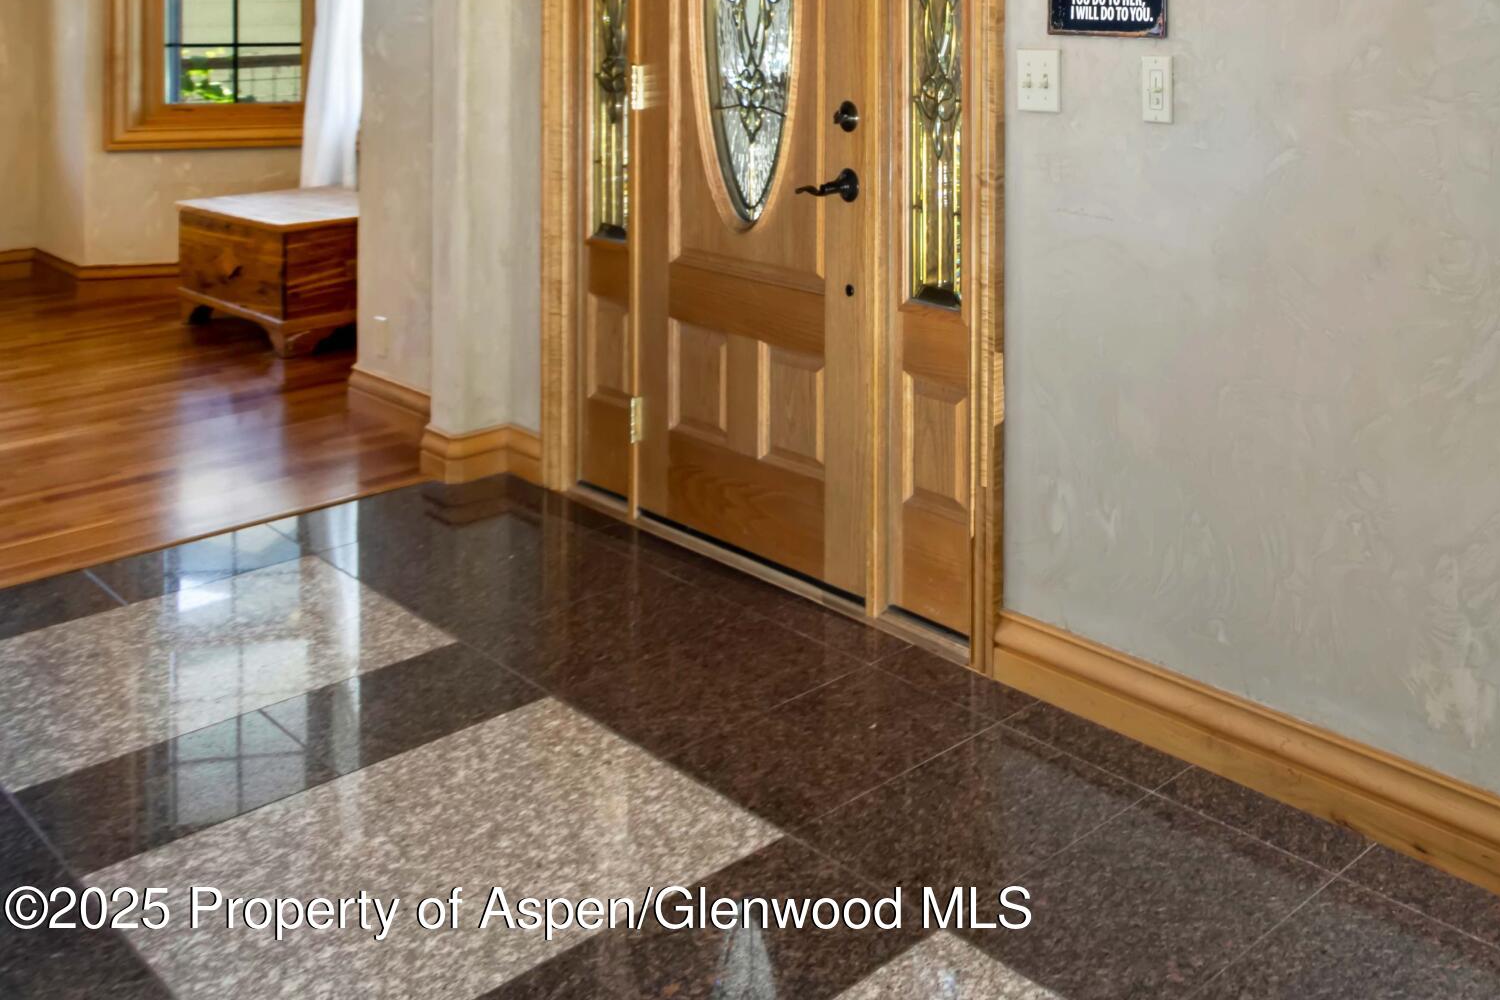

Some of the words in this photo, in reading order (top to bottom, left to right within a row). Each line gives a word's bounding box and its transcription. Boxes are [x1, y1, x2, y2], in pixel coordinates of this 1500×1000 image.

[1071, 6, 1074, 19] I
[1076, 6, 1099, 20] WILL
[1100, 7, 1114, 21] DO
[1115, 7, 1129, 21] TO
[1130, 7, 1153, 22] YOU.
